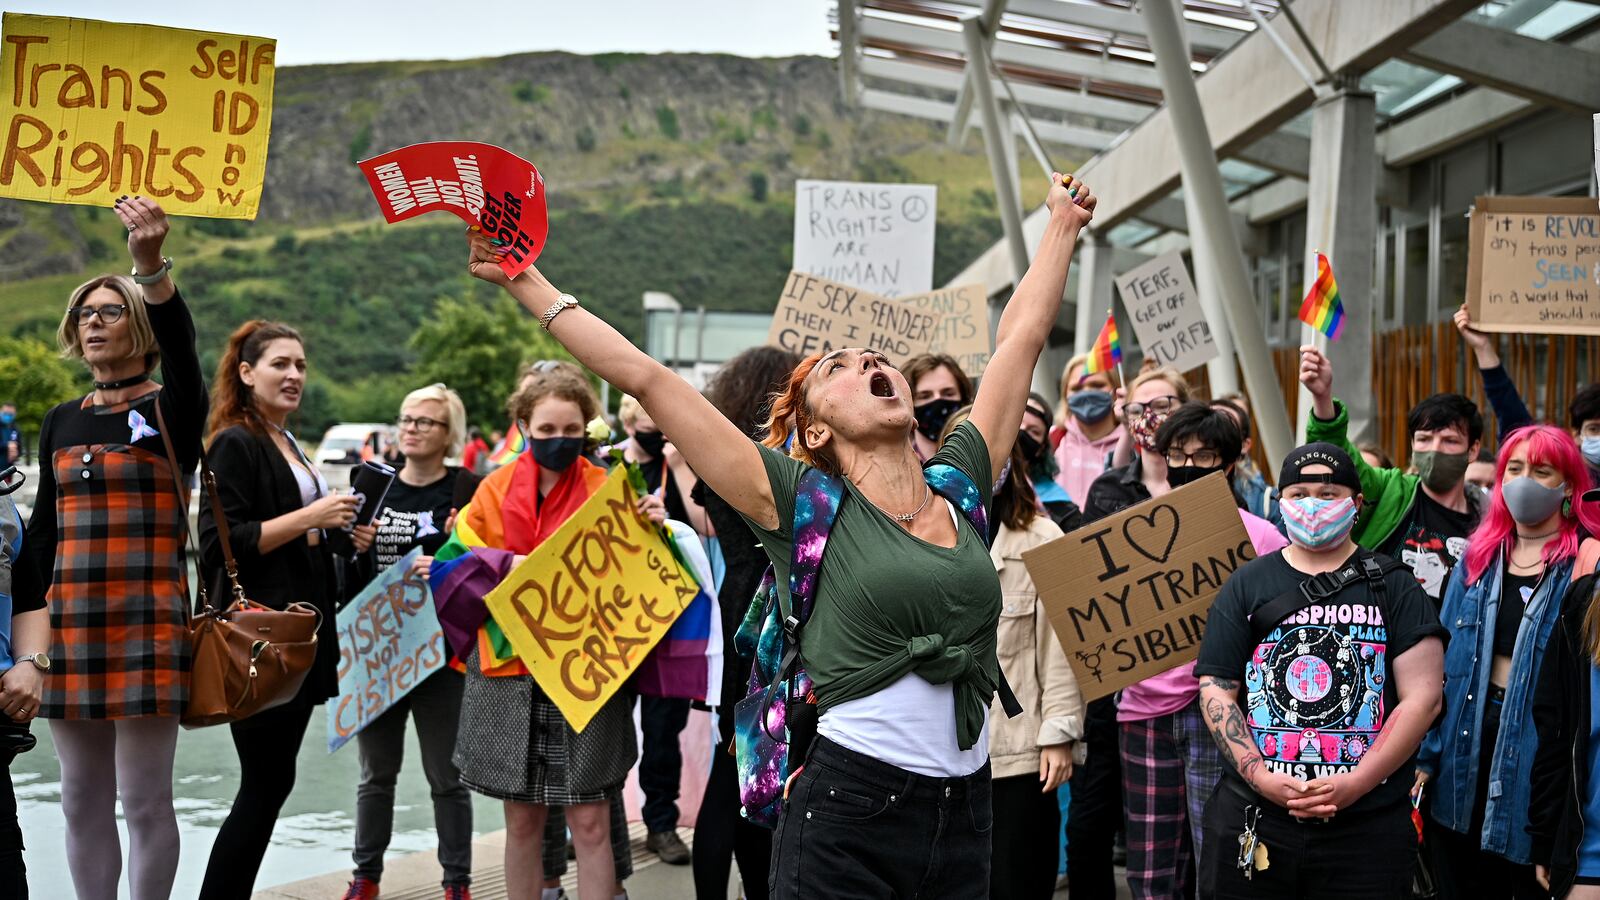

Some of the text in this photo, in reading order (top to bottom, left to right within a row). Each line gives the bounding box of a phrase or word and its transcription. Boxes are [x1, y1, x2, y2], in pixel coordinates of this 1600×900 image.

[6, 35, 167, 115] Trans
[190, 39, 276, 85] Self
[213, 89, 259, 135] ID
[0, 114, 206, 203] Rights
[374, 162, 417, 216] WOMEN
[409, 177, 441, 207] WILL
[436, 180, 465, 209] NOT
[453, 154, 485, 222] SUBMIT.
[802, 186, 892, 211] TRANS
[481, 191, 502, 233] GET
[498, 191, 522, 247] OVER
[808, 210, 892, 239] RIGHTS
[510, 230, 534, 263] IT!
[832, 241, 869, 257] ARE
[1490, 237, 1517, 256] any
[1529, 240, 1567, 257] trans
[1531, 258, 1587, 288] SEEN
[785, 274, 818, 302] IF
[818, 284, 858, 317] SEX
[870, 300, 933, 342] GENDER
[1135, 292, 1185, 323] GET OFF
[1489, 288, 1588, 304] in a world that
[1157, 315, 1179, 332] our
[1539, 305, 1583, 320] should
[785, 306, 832, 332] THEN
[842, 324, 859, 339] I
[869, 333, 911, 356] HAD
[1294, 452, 1340, 466] BANGKOK
[378, 525, 416, 534] radical
[392, 517, 411, 526] the
[376, 534, 412, 544] notion
[377, 544, 398, 553] that
[377, 555, 402, 563] wom
[509, 479, 658, 660] REFORM
[1081, 527, 1129, 583] I
[1067, 539, 1256, 642] MY TRANS
[590, 584, 632, 640] the
[1112, 608, 1210, 672] SIBLIN
[1349, 625, 1387, 641] PLACE
[365, 633, 401, 679] NOT
[1264, 760, 1308, 782] THIS
